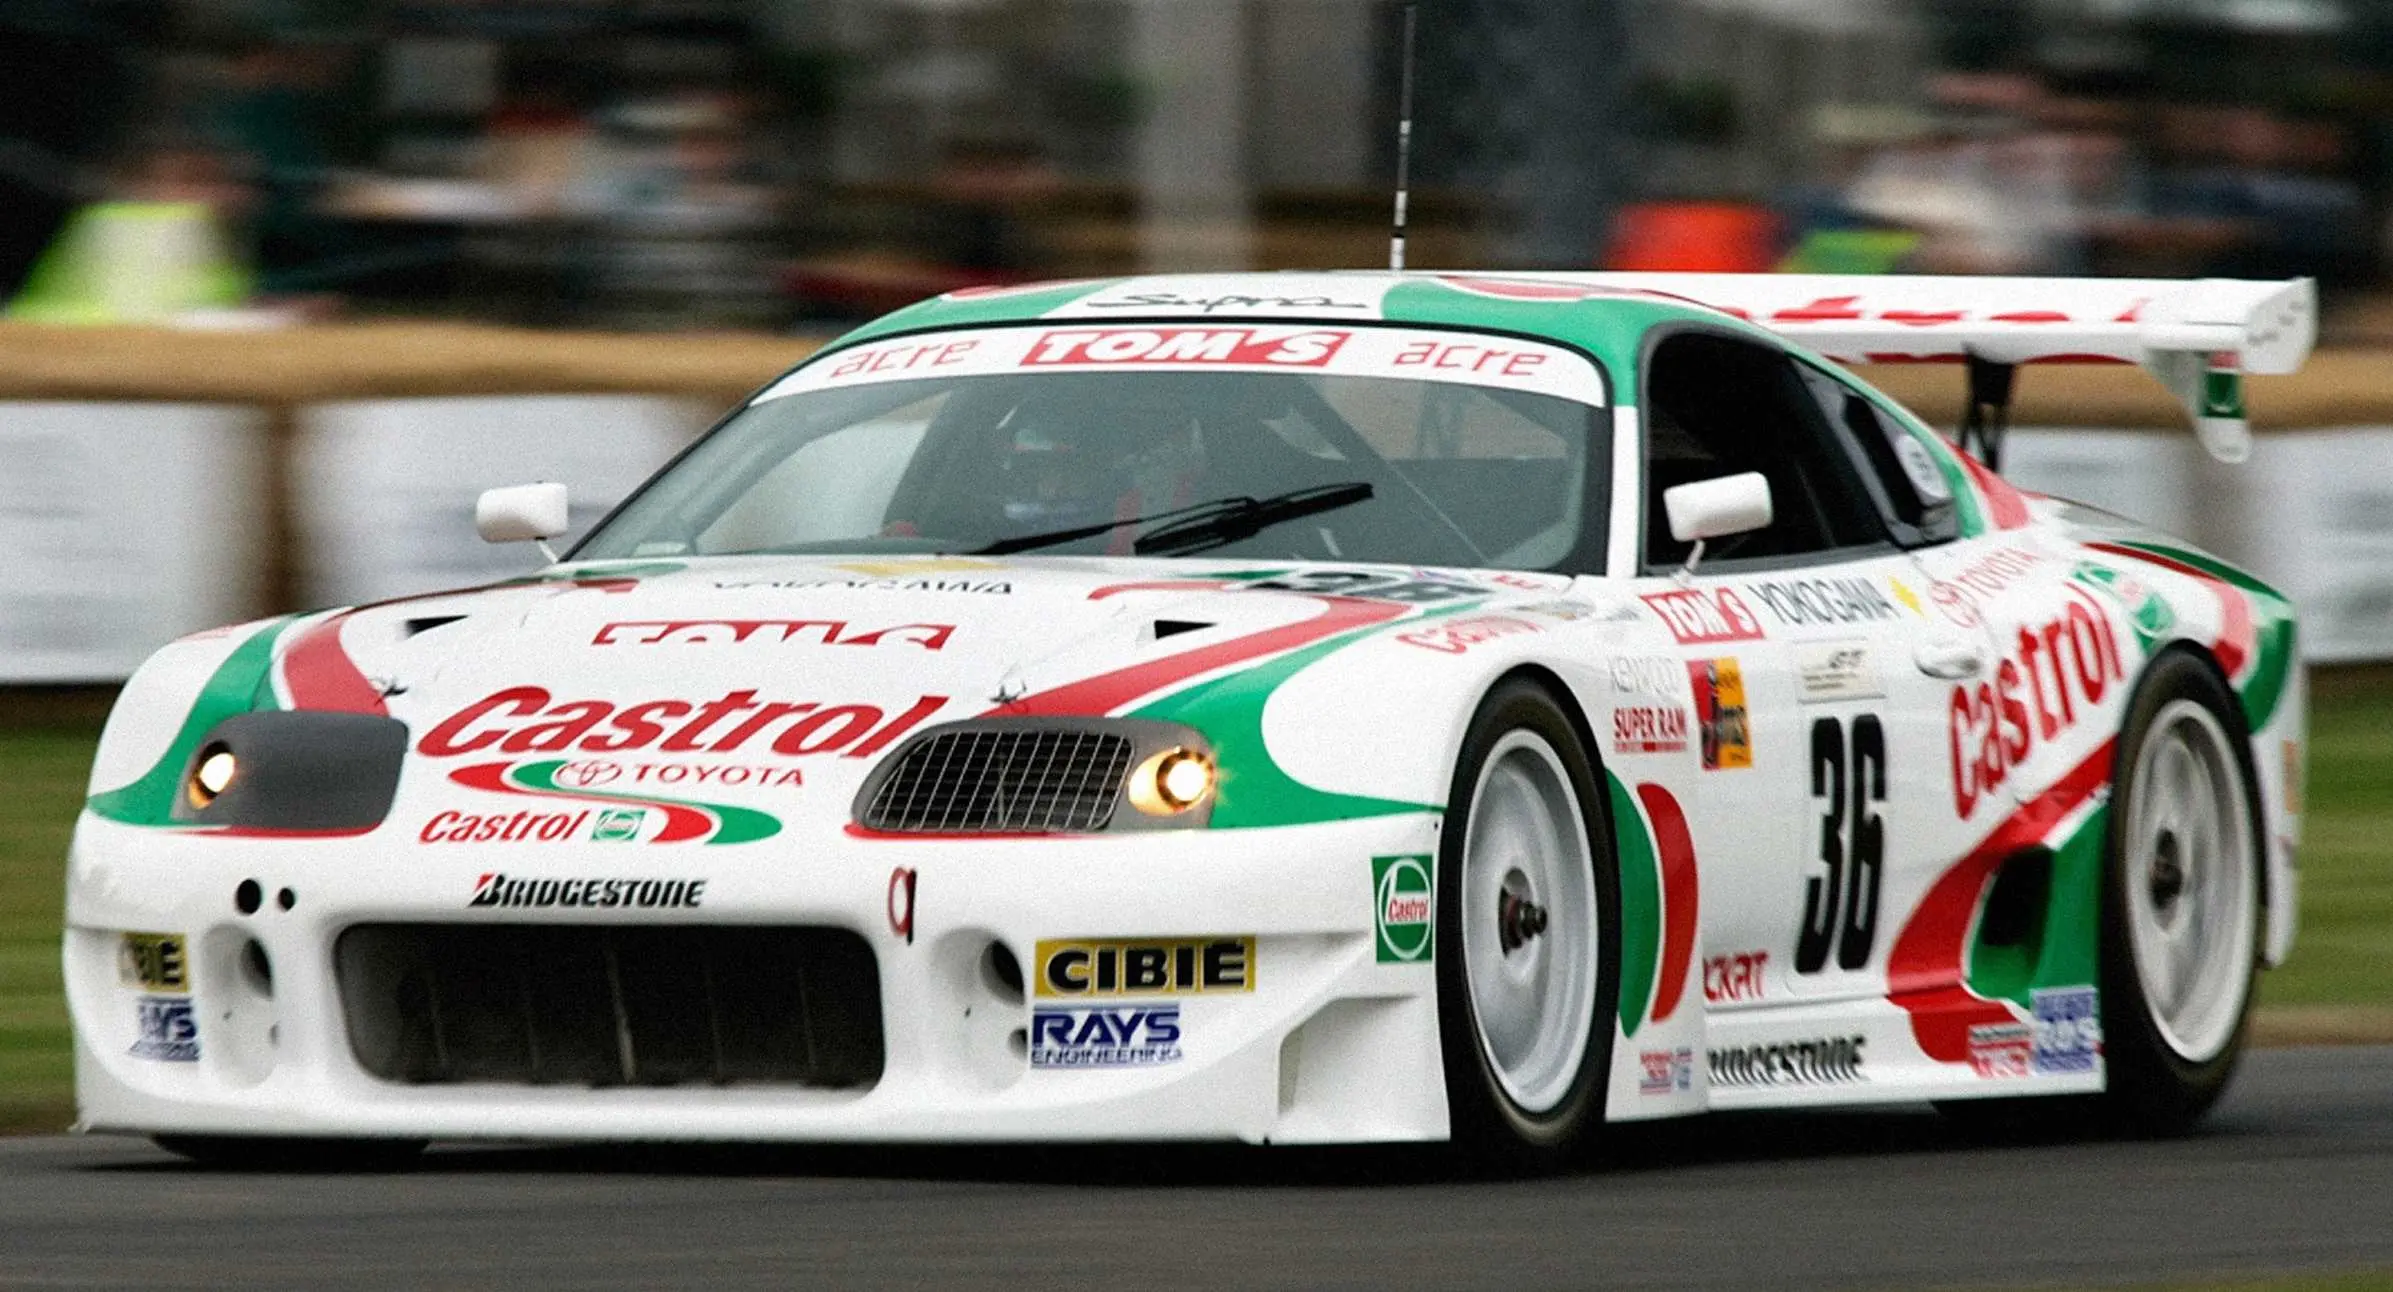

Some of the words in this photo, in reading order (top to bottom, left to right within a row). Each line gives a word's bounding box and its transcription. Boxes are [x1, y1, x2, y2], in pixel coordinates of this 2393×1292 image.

[833, 339, 982, 378] acre
[1036, 330, 1344, 363] TOM'S
[1395, 341, 1545, 377] acre
[1655, 590, 1758, 638] TOM'S
[1747, 580, 1900, 624] YOKOGAWA
[1950, 582, 2123, 820] Castrol
[417, 686, 948, 758] Castrol
[1613, 706, 1656, 739] SUPER
[634, 765, 804, 786] TOYOTA
[418, 809, 590, 843] Castrol
[1795, 714, 1887, 974] 36
[470, 874, 707, 908] BRIDGESTONE
[1388, 897, 1428, 922] Castrol
[1033, 1010, 1181, 1045] RAYS
